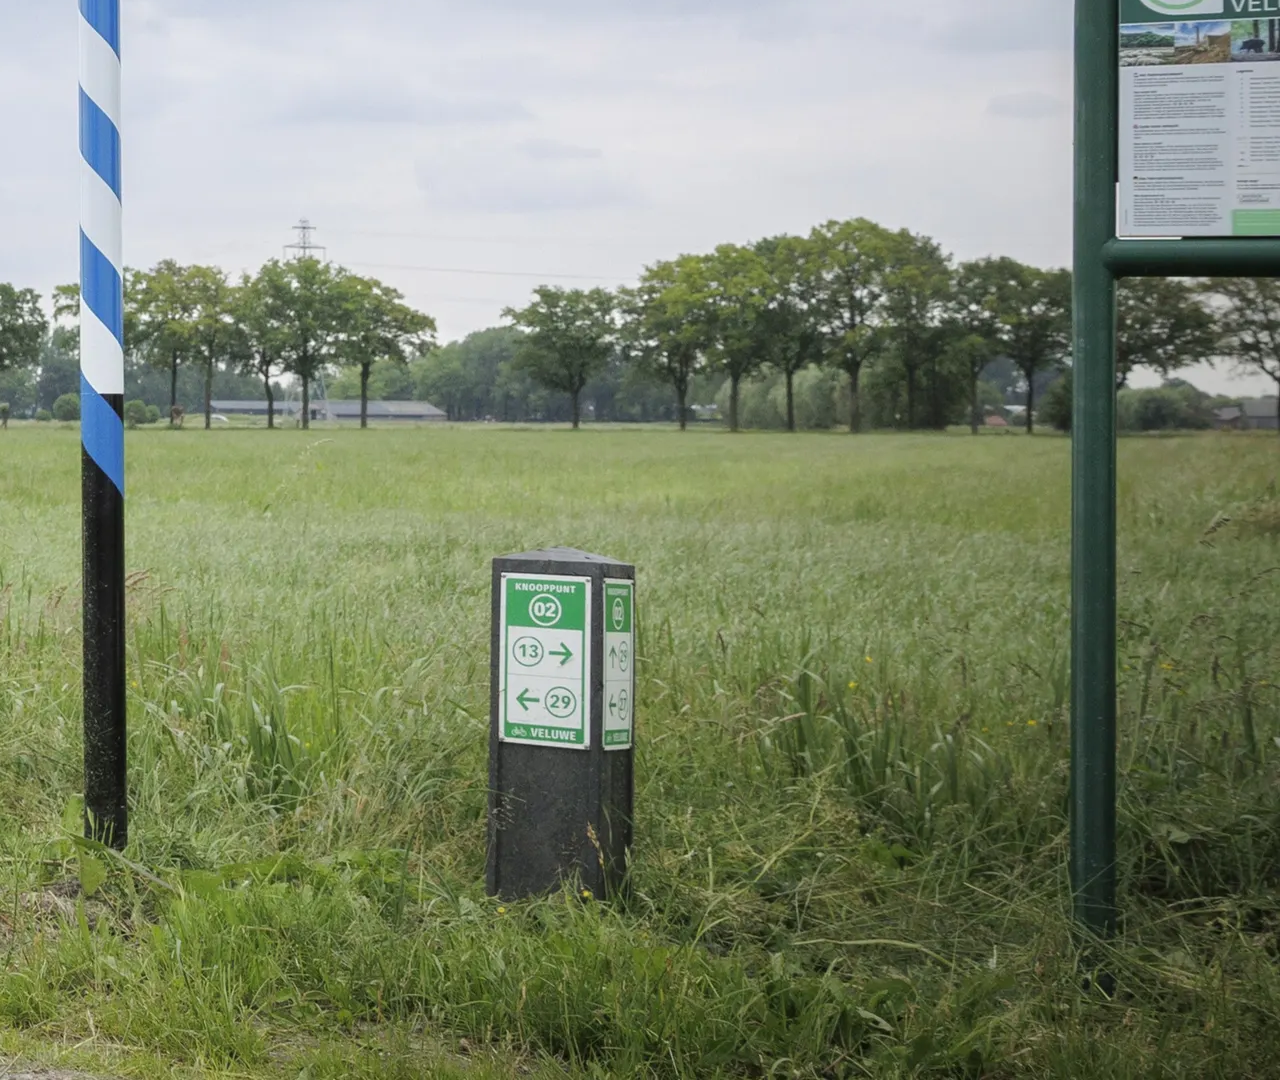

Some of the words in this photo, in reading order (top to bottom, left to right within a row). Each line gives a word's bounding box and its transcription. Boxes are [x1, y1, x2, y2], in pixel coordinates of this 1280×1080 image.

[515, 583, 576, 593] KNOOPPUNT
[534, 602, 556, 617] 02
[519, 644, 538, 658] 13
[550, 694, 571, 709] 29
[530, 728, 576, 740] VELUWE
